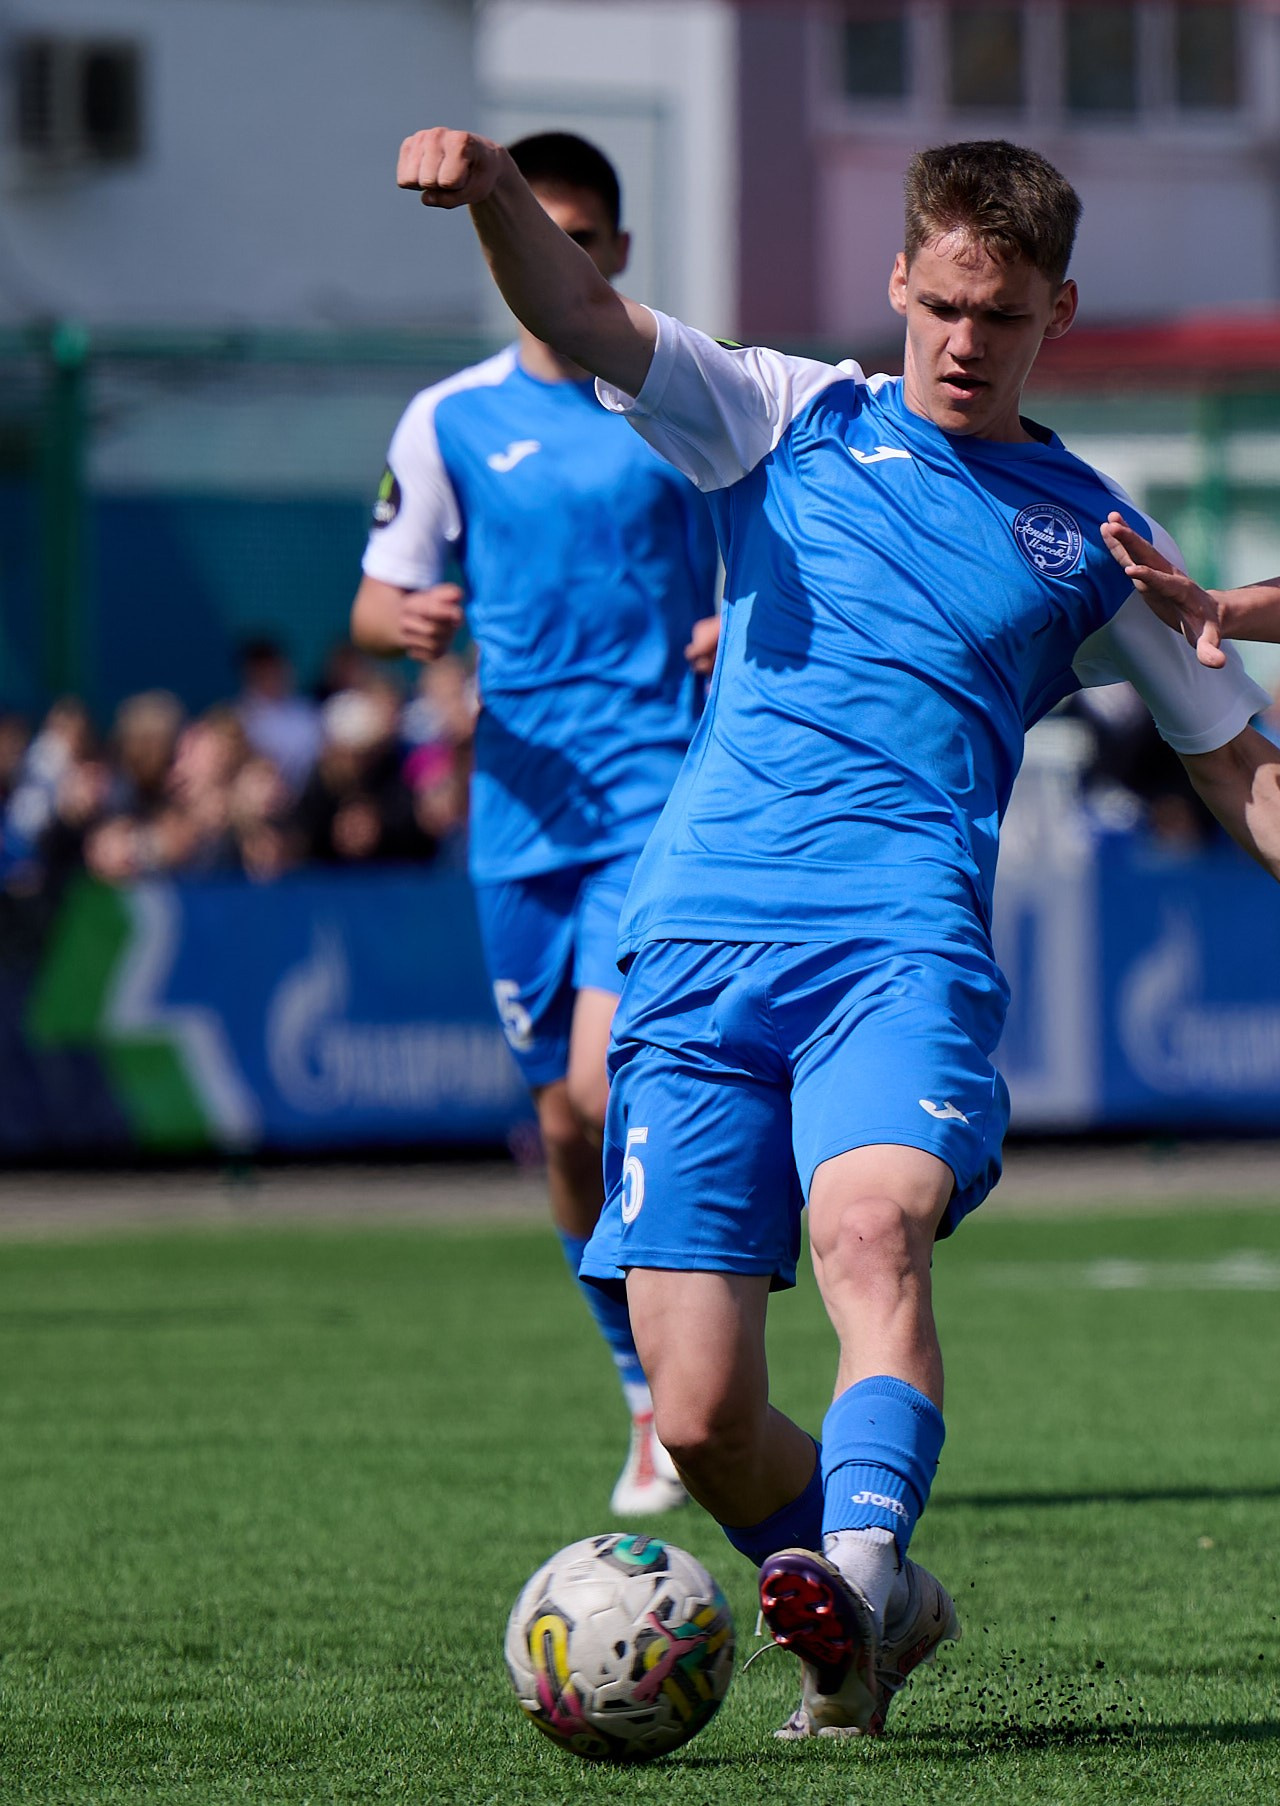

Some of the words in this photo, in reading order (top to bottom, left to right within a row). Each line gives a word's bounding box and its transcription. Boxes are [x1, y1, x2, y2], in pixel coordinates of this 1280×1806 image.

[1016, 521, 1056, 544] Зенит
[1028, 538, 1075, 561] Ижевск
[621, 1126, 649, 1224] 5
